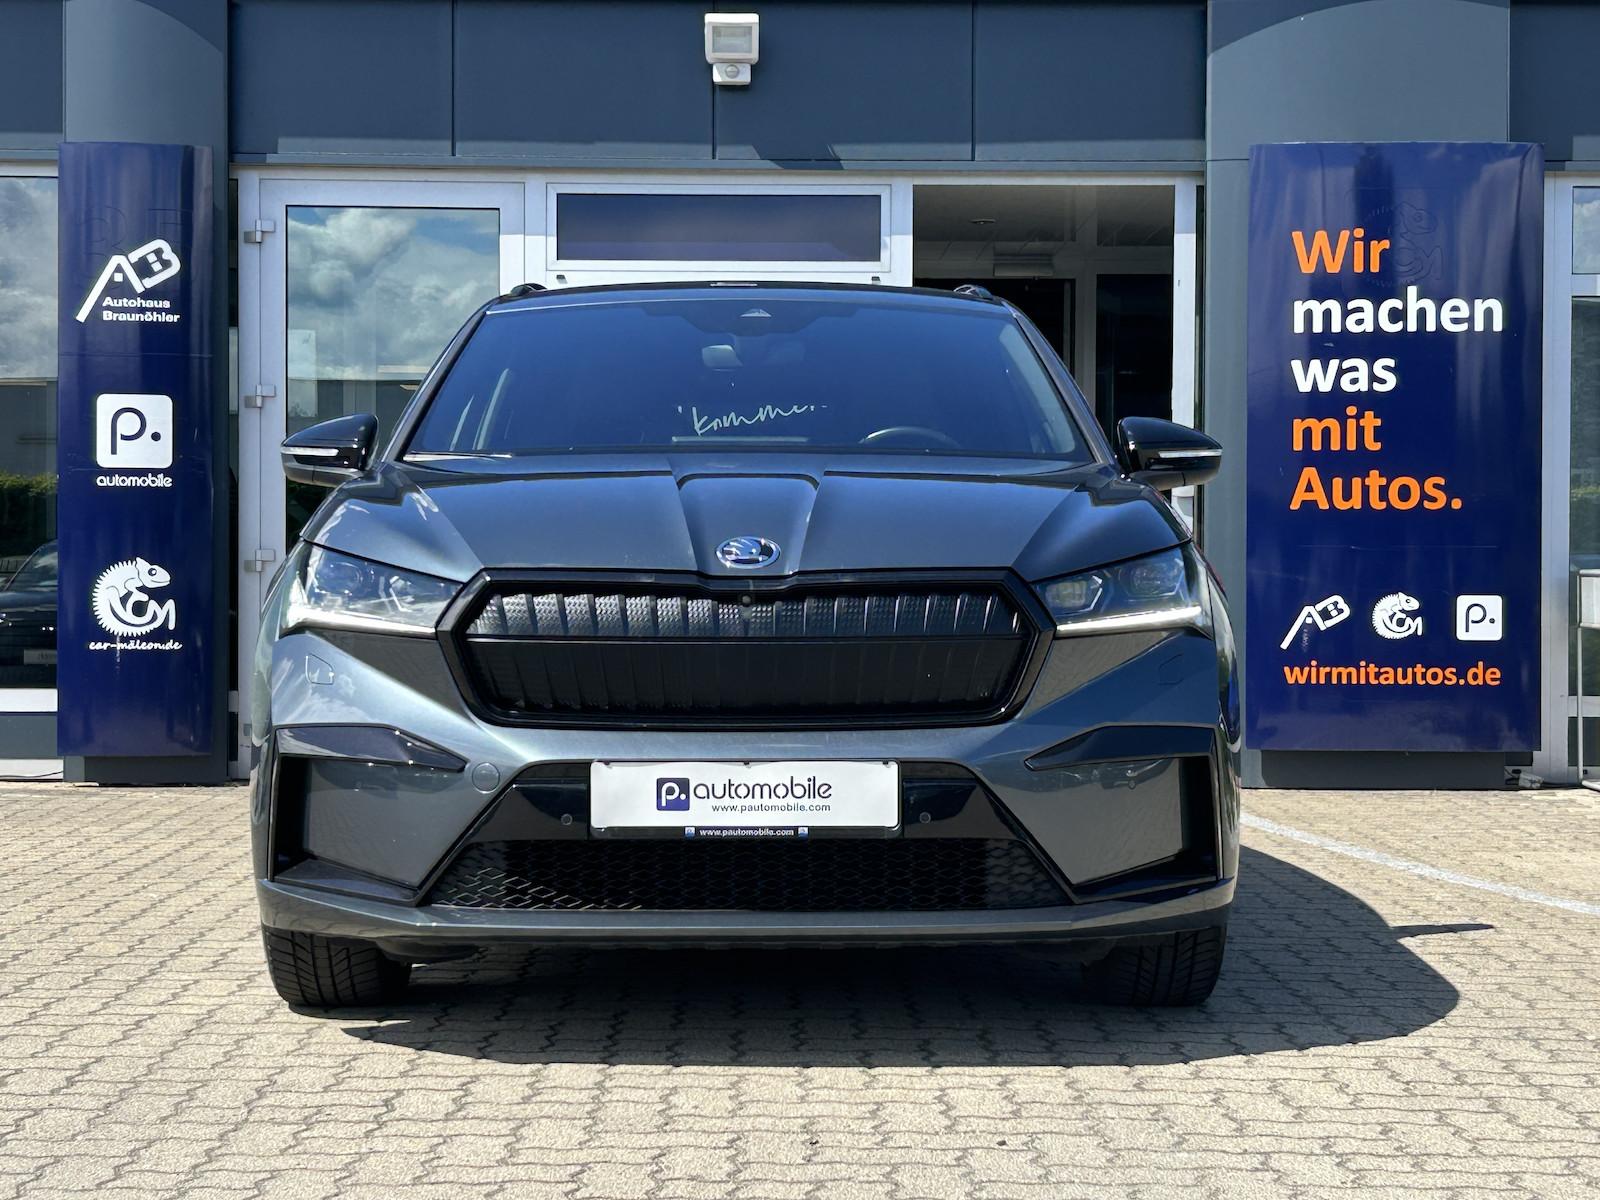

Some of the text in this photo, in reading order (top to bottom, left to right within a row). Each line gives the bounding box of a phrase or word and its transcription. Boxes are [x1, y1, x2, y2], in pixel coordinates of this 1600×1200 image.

[1292, 228, 1390, 273] Wir
[102, 296, 171, 308] Autohaus
[1293, 285, 1504, 333] machen
[103, 310, 180, 322] Braunöhler
[1290, 357, 1398, 393] was
[1292, 405, 1382, 451] mit
[96, 473, 173, 487] automobile
[1289, 466, 1462, 510] Autos.
[1283, 660, 1502, 686] wirmitautos.de
[693, 776, 832, 799] automobile
[711, 803, 831, 812] www.pautomobile.com
[699, 828, 794, 837] www.pautomobile.com
